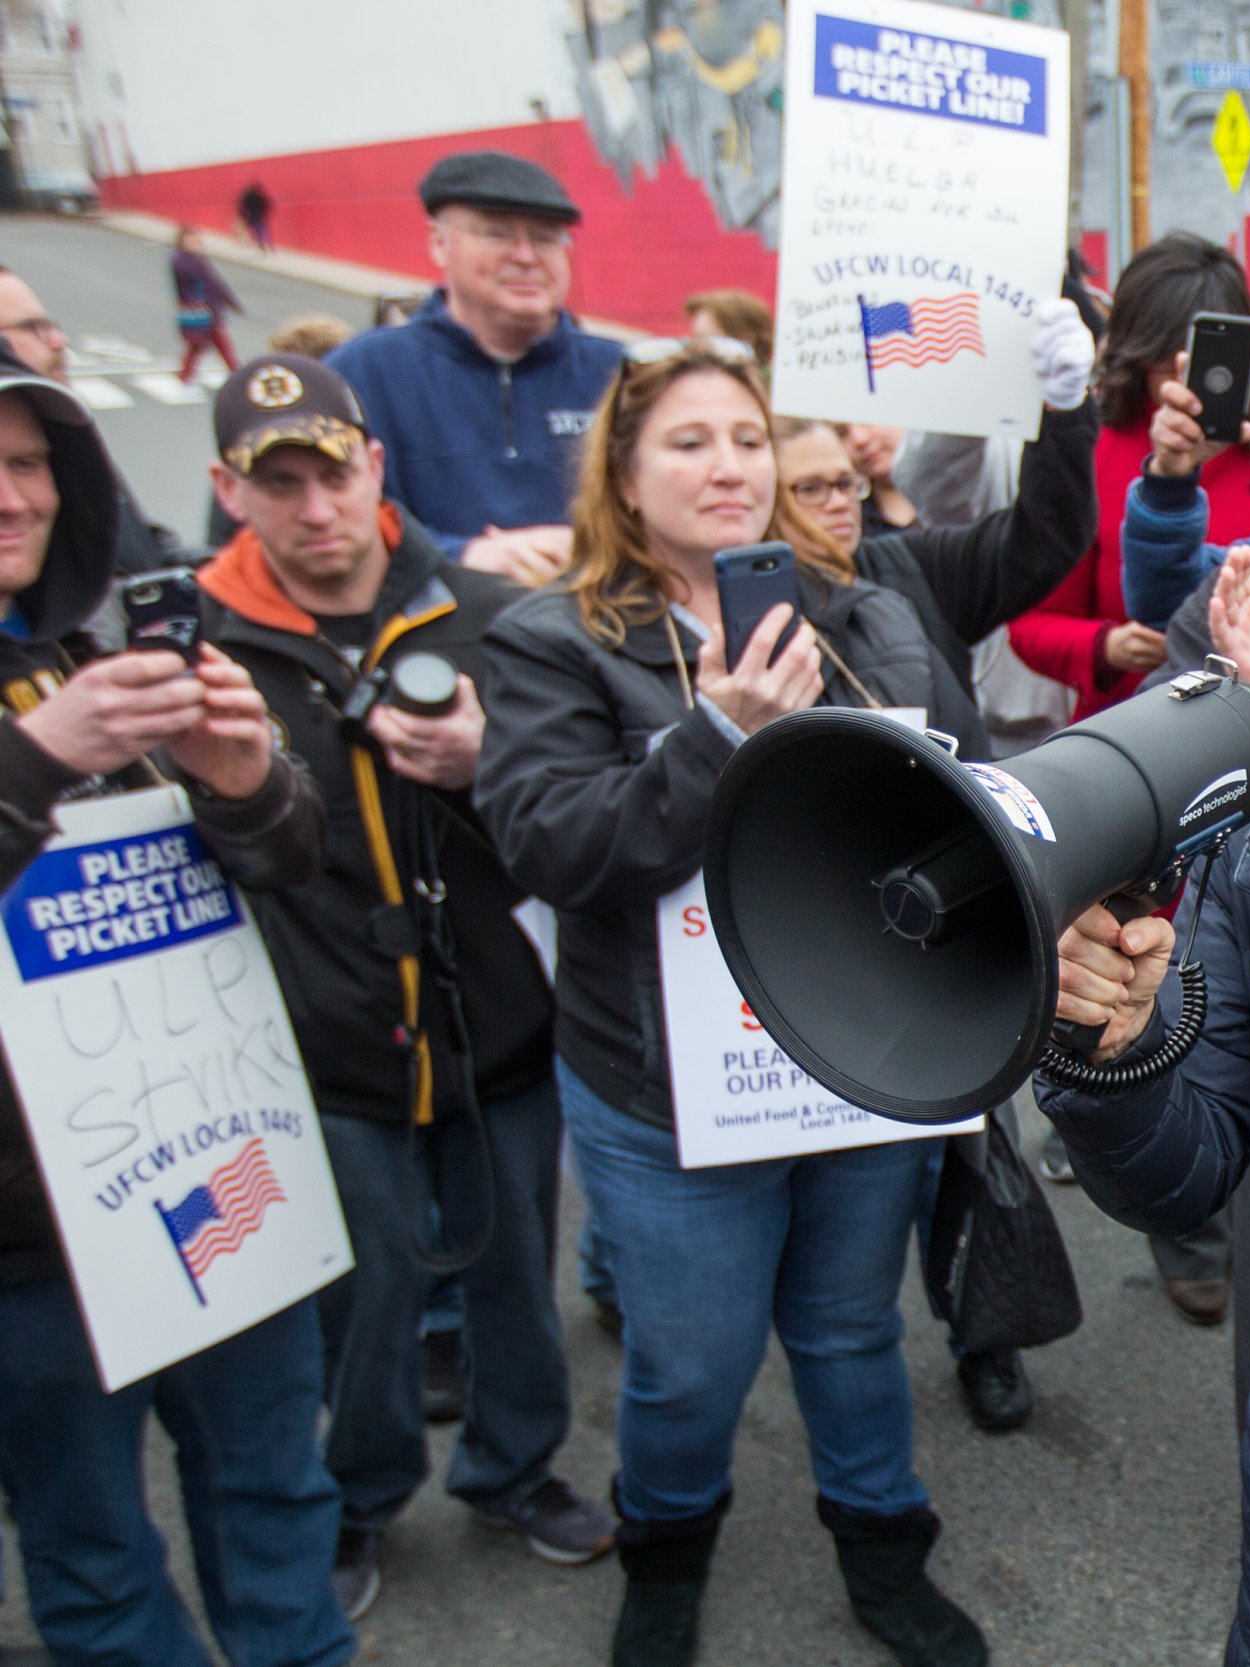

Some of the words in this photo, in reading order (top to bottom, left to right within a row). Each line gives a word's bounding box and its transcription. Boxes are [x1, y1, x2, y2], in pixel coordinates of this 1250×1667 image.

[832, 43, 962, 90] RESPECT
[965, 71, 1031, 103] OUR
[878, 29, 987, 73] PLEASE
[837, 70, 945, 110] PICKET
[948, 90, 1025, 125] LINE!
[813, 253, 889, 286] UFCW
[897, 255, 975, 290] LOCAL
[984, 274, 1037, 319] 1445
[1179, 807, 1203, 827] speco
[1203, 784, 1248, 814] technologies
[79, 834, 191, 887] PLEASE
[27, 871, 180, 932] RESPECT
[180, 859, 228, 896] OUR
[46, 904, 172, 962] PICKET
[172, 889, 234, 932] LINE!
[54, 936, 250, 1060] ULP
[723, 1048, 793, 1072] PLEA
[726, 1071, 782, 1096] OUR
[715, 1112, 761, 1129] United
[765, 1107, 798, 1122] Food
[802, 1104, 812, 1117] &
[800, 1112, 836, 1131] Local
[96, 1140, 177, 1212] UFCW
[180, 1111, 256, 1157] LOCAL
[259, 1108, 304, 1139] 1445
